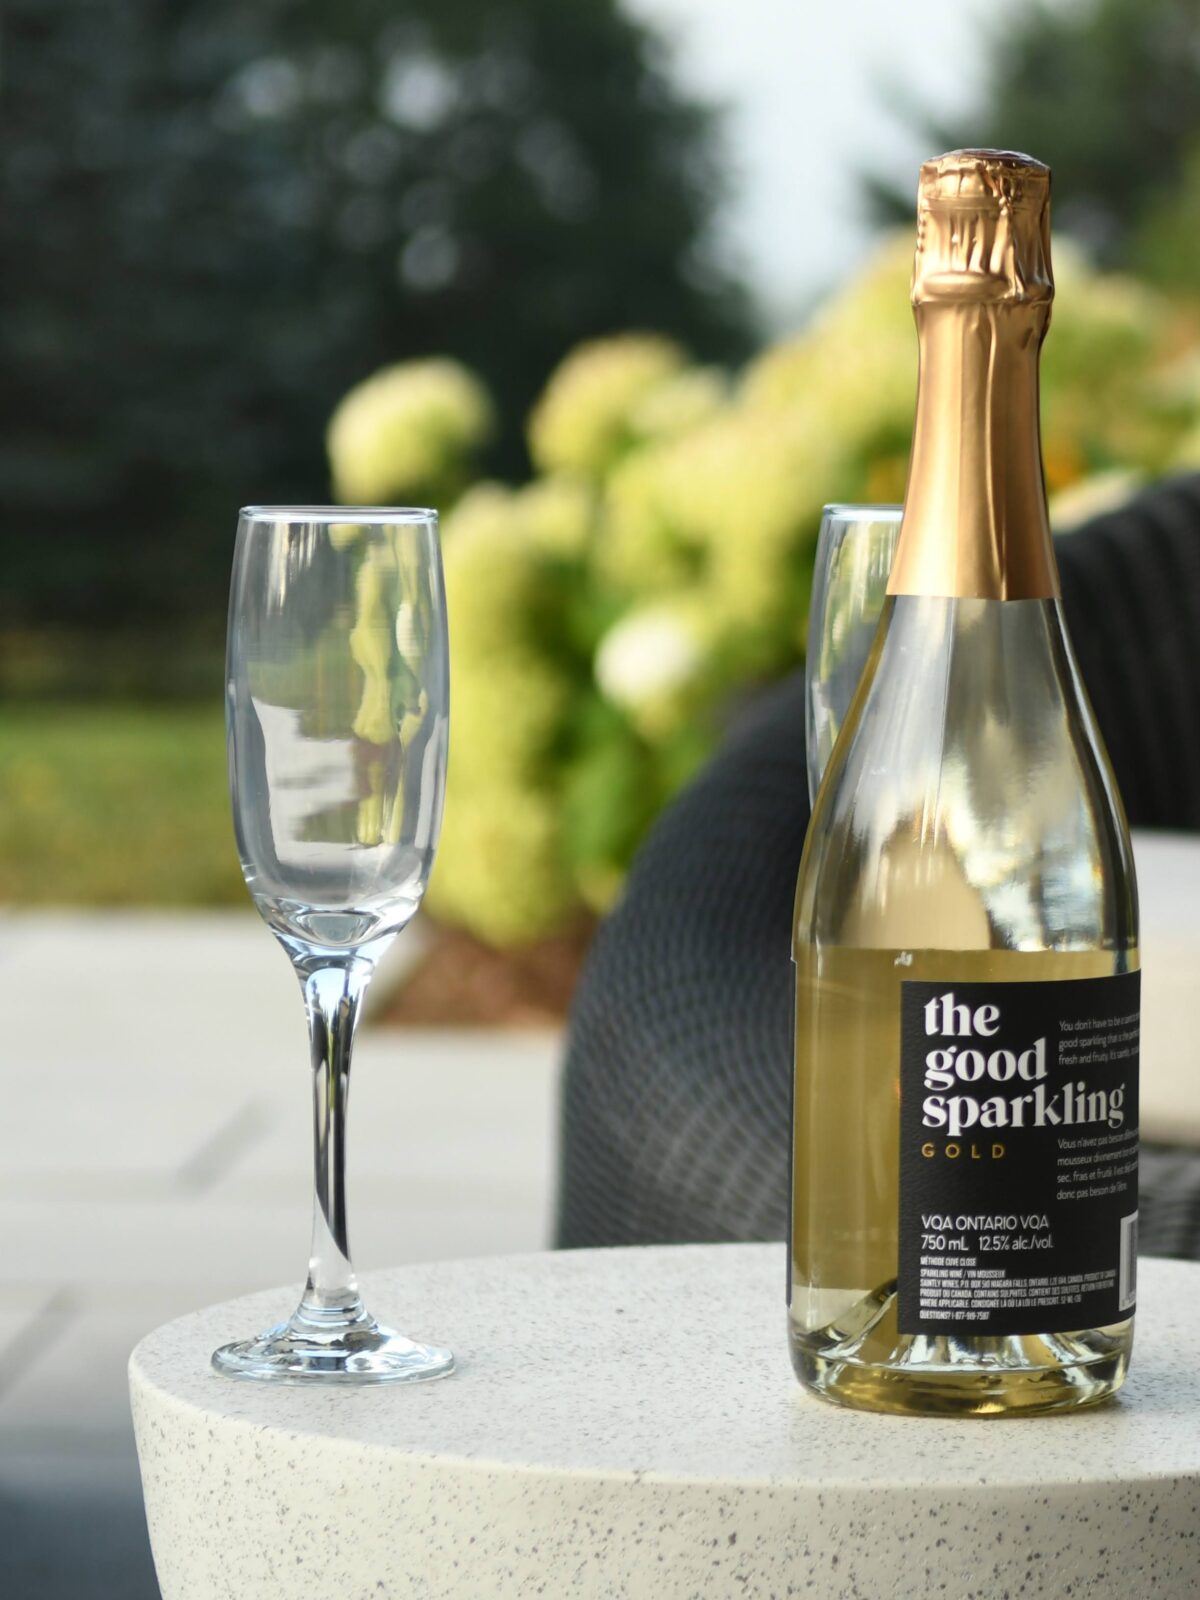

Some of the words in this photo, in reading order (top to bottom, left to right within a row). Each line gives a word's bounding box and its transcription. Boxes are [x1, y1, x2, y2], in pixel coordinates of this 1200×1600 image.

[924, 992, 1000, 1037] the
[1059, 1020, 1073, 1031] You
[1058, 1037, 1078, 1052] good
[1079, 1035, 1107, 1048] sparkling
[923, 1037, 1048, 1091] good
[1058, 1054, 1078, 1065] fresh
[1079, 1052, 1092, 1064] and
[921, 1080, 1125, 1137] sparkling
[1058, 1138, 1076, 1149] Vous
[921, 1142, 1005, 1159] GOLD
[1057, 1155, 1092, 1166] mousseux
[1073, 1170, 1088, 1182] frais
[1056, 1188, 1075, 1200] donc
[1076, 1189, 1089, 1200] pas
[921, 1215, 953, 1231] VQA
[955, 1215, 1017, 1231] ONTARIO
[1020, 1214, 1049, 1230] VQA
[920, 1234, 946, 1250] 750
[948, 1236, 969, 1251] mL
[979, 1235, 1010, 1251] 12.5%
[920, 1268, 948, 1278] SPARKLING
[967, 1270, 976, 1278] VIN
[991, 1279, 1012, 1288] NIAGARA
[920, 1288, 942, 1298] PRODUIT
[973, 1289, 999, 1298] CONTAINS
[920, 1310, 951, 1320] QUESTIONS?
